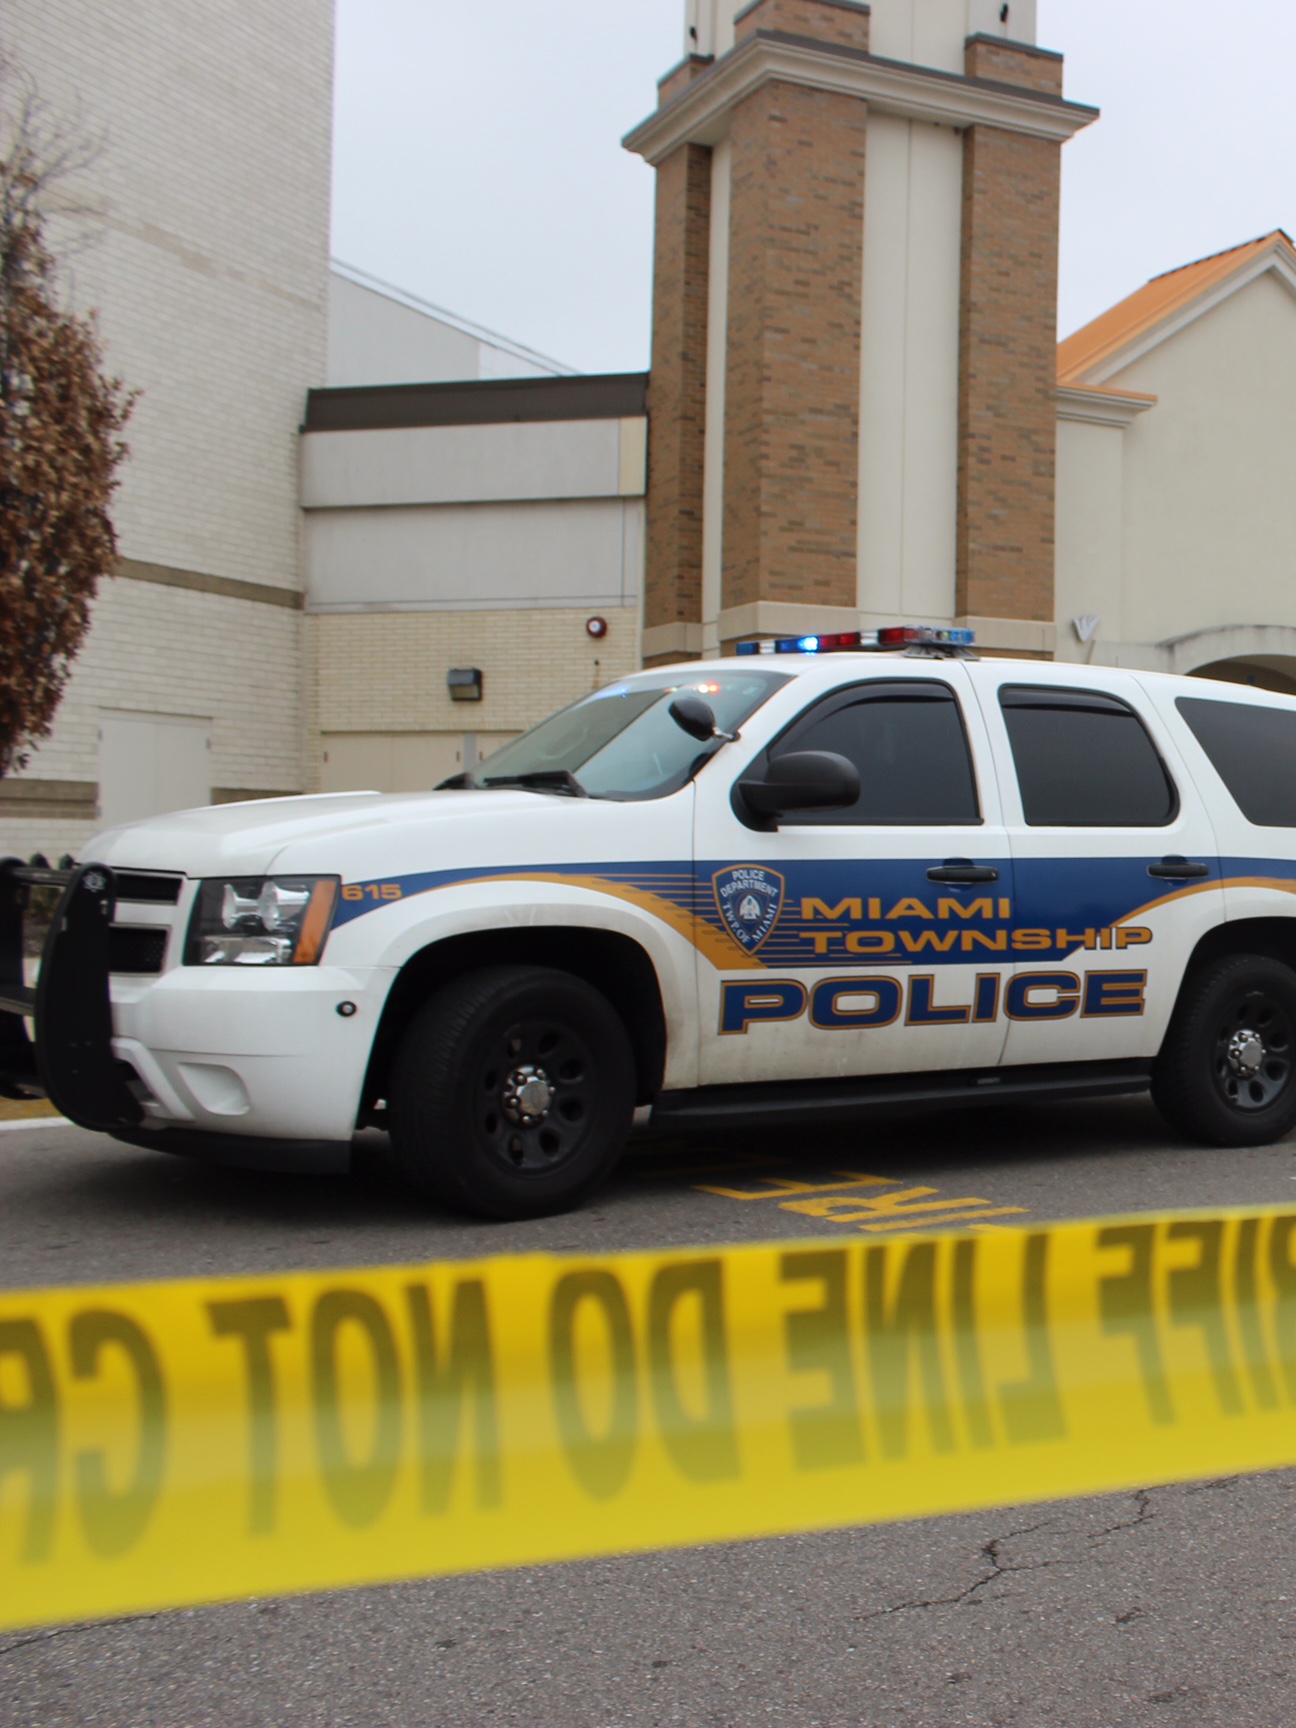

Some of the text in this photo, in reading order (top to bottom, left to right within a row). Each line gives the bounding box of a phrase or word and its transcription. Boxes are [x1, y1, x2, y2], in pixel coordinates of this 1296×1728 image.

[732, 869, 765, 881] POLICE
[341, 884, 402, 901] 615
[720, 879, 779, 898] DEPARTMENT
[800, 897, 1011, 920] MIAMI
[752, 903, 778, 942] MIAMI
[799, 926, 1154, 955] TOWNSHIP
[717, 969, 1148, 1036] POLICE
